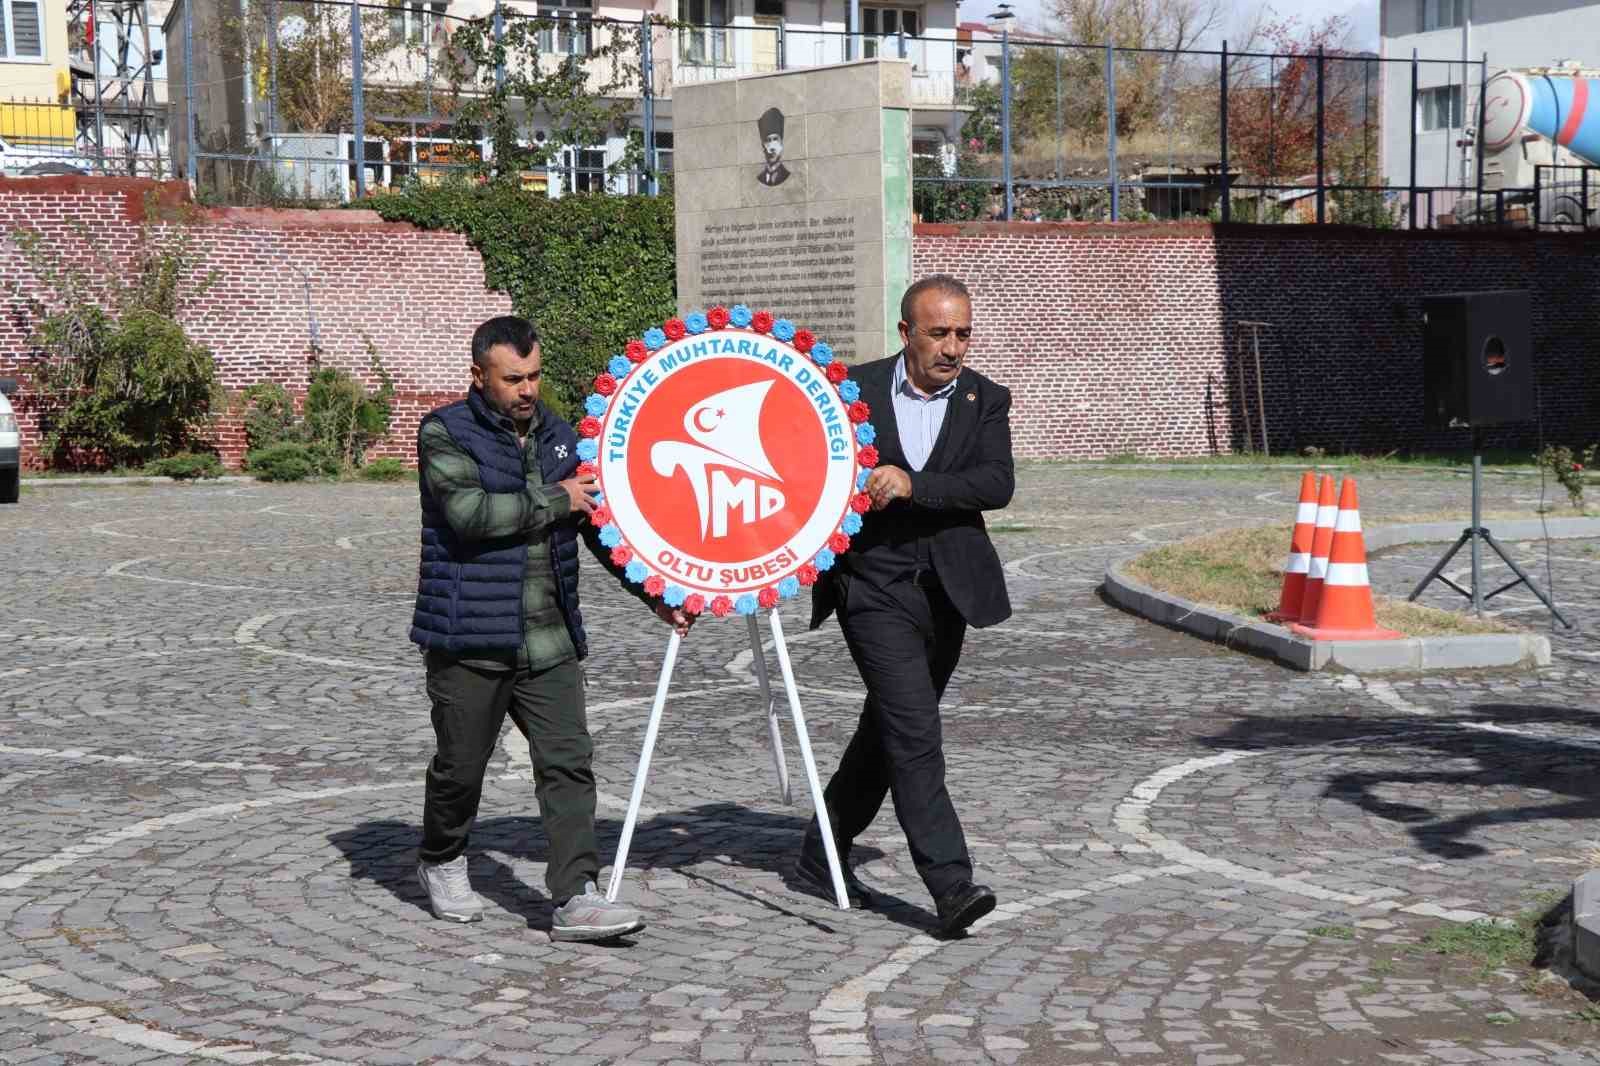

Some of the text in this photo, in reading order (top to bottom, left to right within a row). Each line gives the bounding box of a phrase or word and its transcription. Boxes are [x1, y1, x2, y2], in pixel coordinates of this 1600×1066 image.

[609, 338, 849, 462] TÜRKİYE MUHTARLAR DERNEĞİ
[657, 546, 798, 587] OLTU ŞUBESİ
